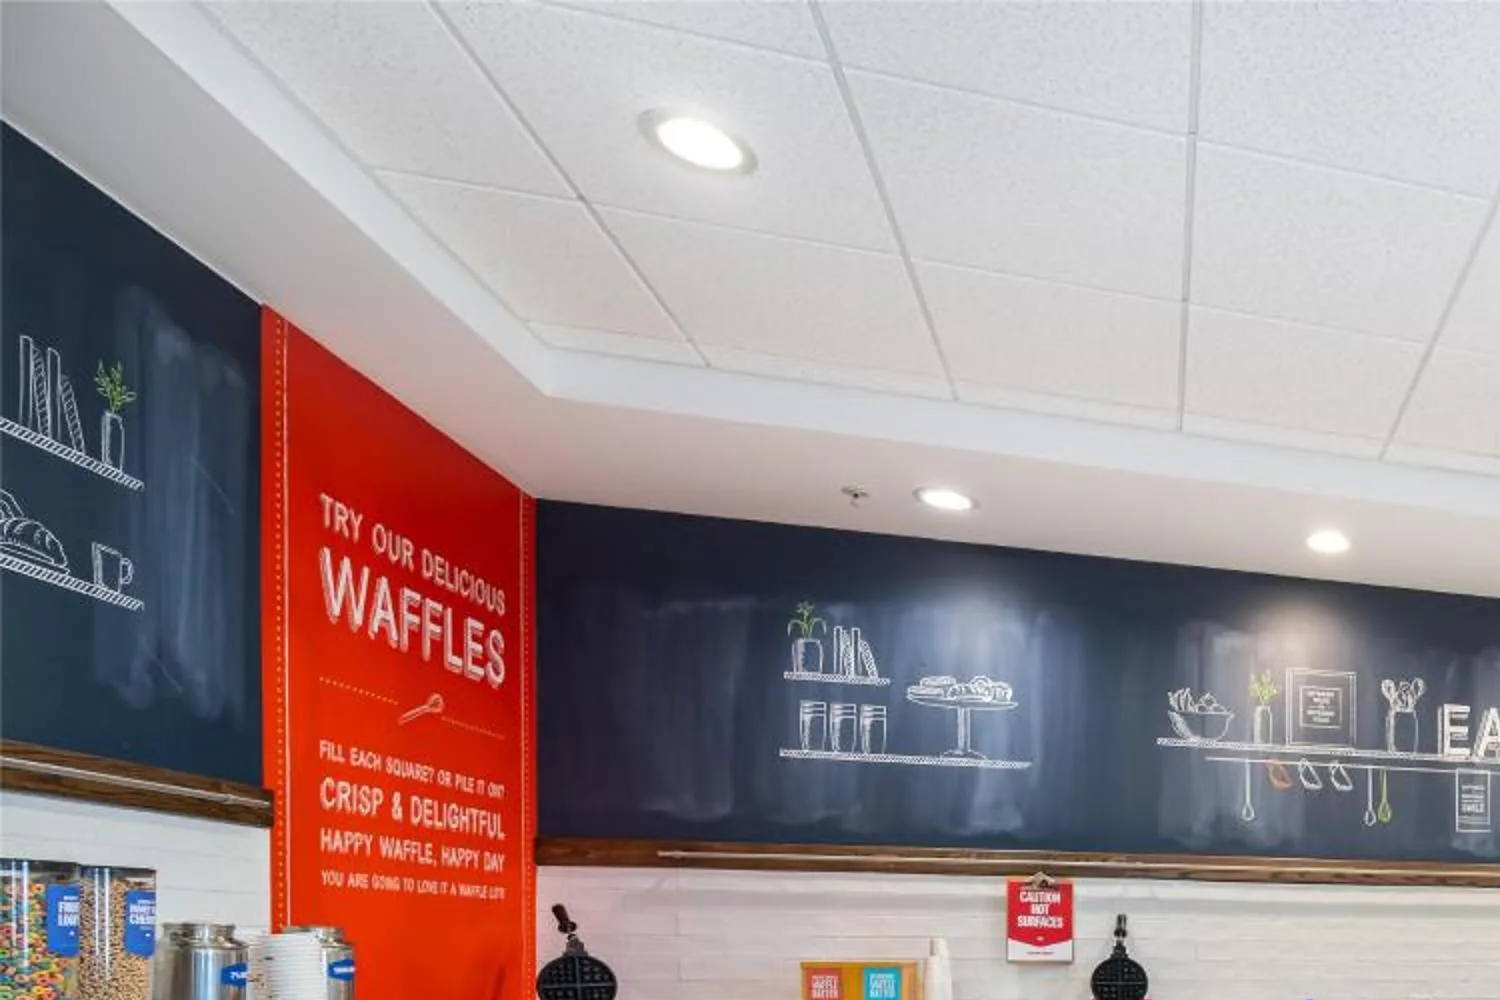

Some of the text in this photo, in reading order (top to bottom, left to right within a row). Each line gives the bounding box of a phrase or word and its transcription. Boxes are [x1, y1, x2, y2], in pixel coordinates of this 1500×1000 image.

[319, 492, 505, 616] TRY OUR DELICIOUS
[319, 545, 505, 689] WAFFLES
[319, 740, 345, 762] FILL
[350, 747, 382, 771] EACH
[385, 756, 434, 784] SQUARE?
[437, 769, 452, 788] OR
[455, 774, 475, 794] PILE
[320, 776, 506, 840] CRISP & DELIGHTFUL
[320, 827, 505, 873] HAPPY WAFFLE, HAPPY DAY
[321, 869, 344, 886] YOU
[348, 873, 369, 889] ARE
[372, 873, 400, 891] GOING
[402, 877, 415, 892] TO
[417, 880, 438, 894] LOVE
[450, 882, 457, 896] A
[459, 884, 487, 899] WAFFLE
[1019, 891, 1061, 904] CAUTION
[1017, 915, 1063, 929] SURFACES
[1031, 903, 1050, 915] HOT
